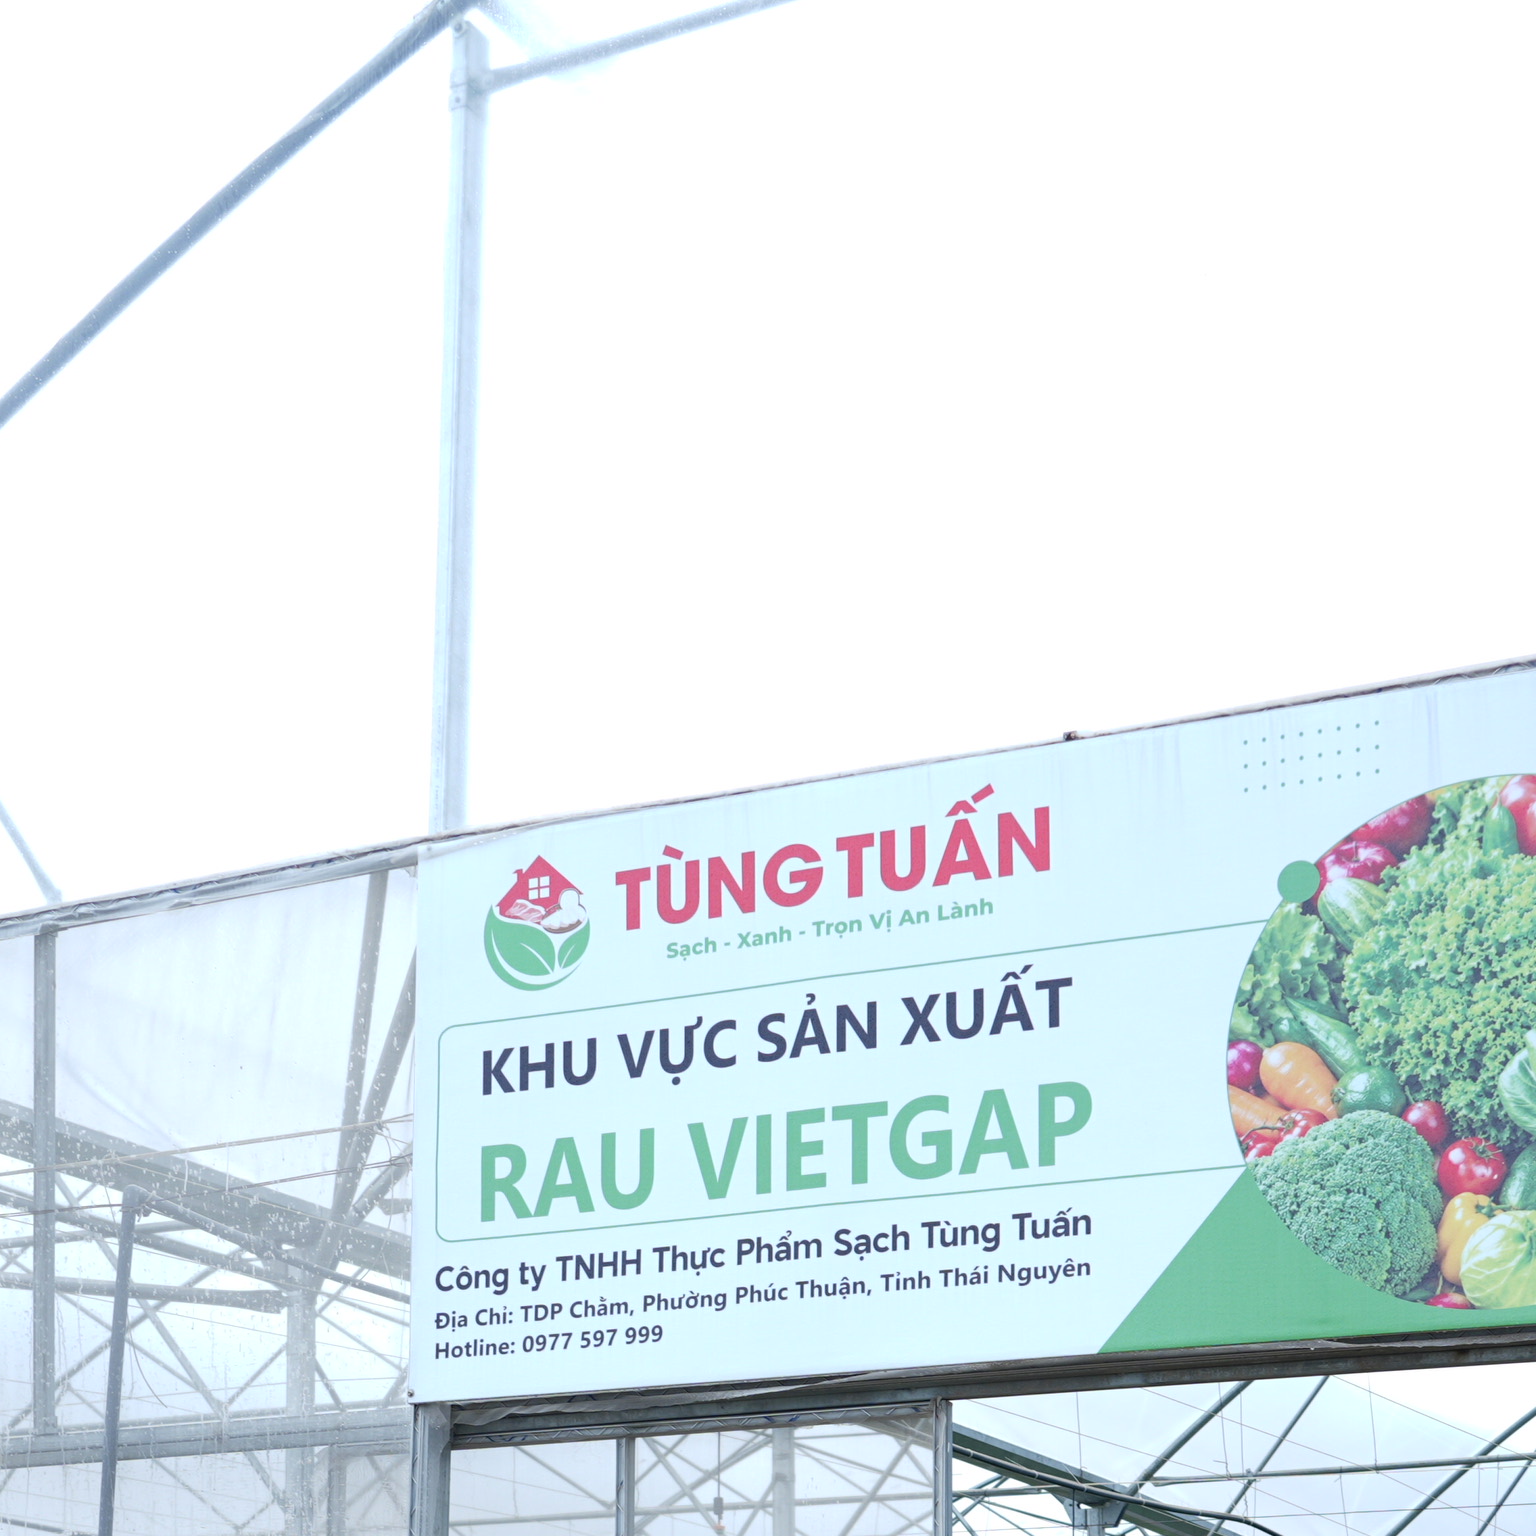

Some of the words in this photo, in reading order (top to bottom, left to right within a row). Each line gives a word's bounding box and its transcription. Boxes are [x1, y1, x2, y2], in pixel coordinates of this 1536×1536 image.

[616, 844, 823, 930] TÙNG
[836, 784, 1050, 898] TUẤN
[667, 937, 717, 961] Sạch
[738, 926, 791, 948] Xanh
[812, 918, 863, 941] Trọn
[869, 910, 891, 932] Vị
[899, 910, 929, 926] An
[938, 898, 993, 921] Lành
[483, 1038, 597, 1095] KHU
[617, 1016, 736, 1085] VỰC
[758, 993, 877, 1062] SẢN
[900, 964, 1072, 1045] XUẤT
[481, 1128, 655, 1222] RAU
[687, 1082, 1092, 1200] VIETGAP
[434, 1311, 468, 1332] Địa
[475, 1306, 513, 1326] Chỉ:
[520, 1303, 563, 1322] TDP
[570, 1296, 634, 1318] Chằm,
[643, 1291, 726, 1312] Phường
[736, 1283, 788, 1304] Phúc
[795, 1277, 871, 1299] Thuận,
[880, 1271, 930, 1292] Tỉnh
[939, 1265, 988, 1287] Thái
[998, 1258, 1090, 1286] Nguyên
[435, 1266, 509, 1295] Công
[519, 1262, 546, 1291] ty
[556, 1249, 641, 1281] TNHH
[652, 1245, 725, 1276] Thực
[737, 1230, 822, 1265] Phẩm
[834, 1224, 910, 1261] Sạch
[921, 1221, 1000, 1252] Tùng
[1012, 1207, 1091, 1240] Tuấn
[435, 1339, 515, 1359] Hotline:
[522, 1332, 573, 1353] 0977
[580, 1329, 617, 1348] 597
[625, 1325, 663, 1344] 999
